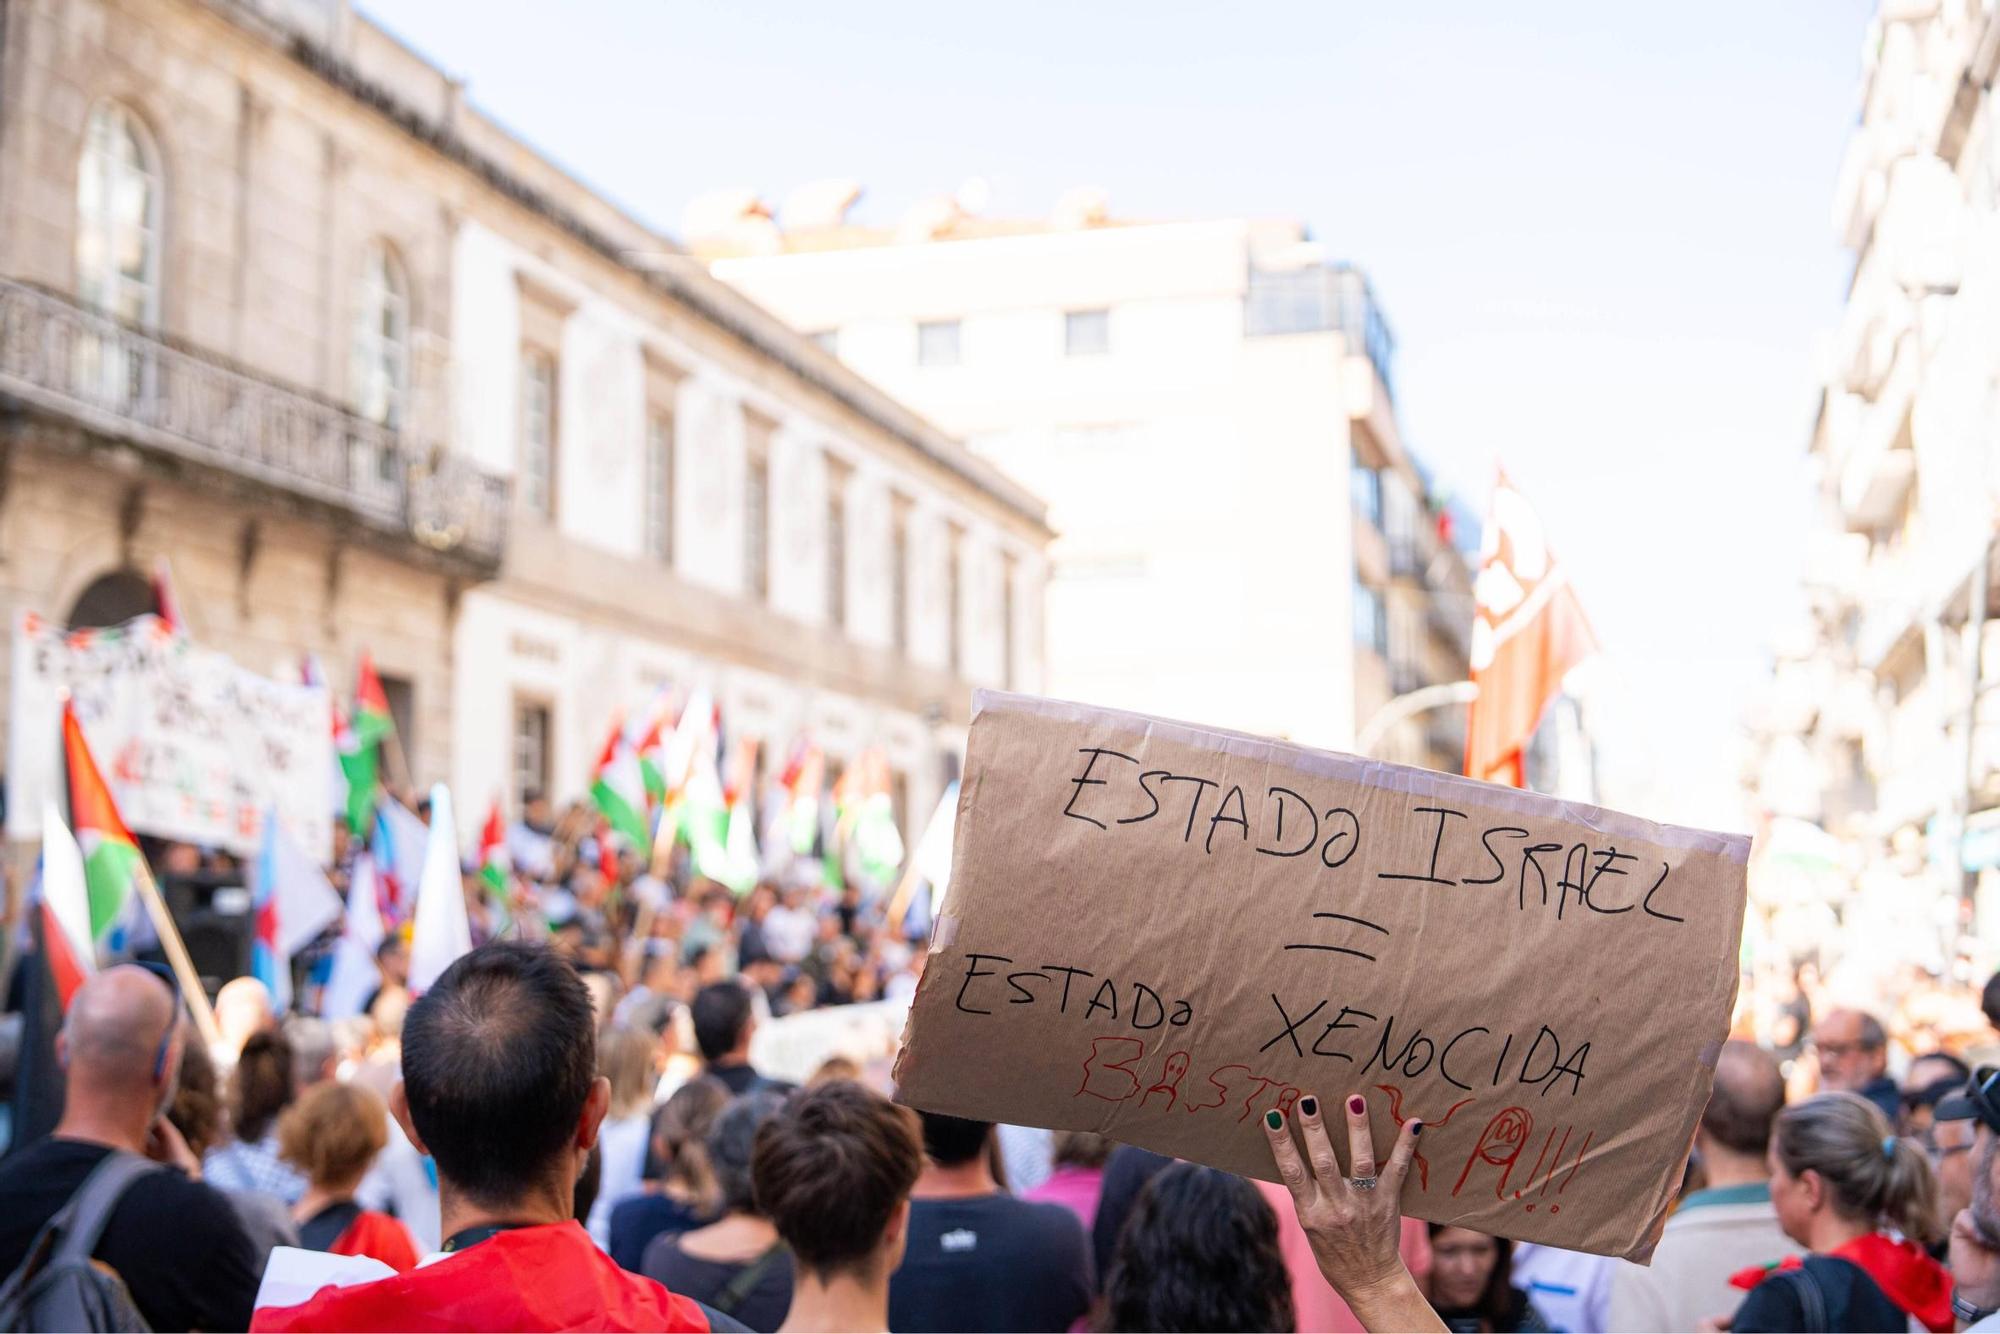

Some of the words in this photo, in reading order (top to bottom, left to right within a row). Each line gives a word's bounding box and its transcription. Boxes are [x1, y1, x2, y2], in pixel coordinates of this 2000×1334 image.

[1063, 748, 1361, 868] ESTADO
[1377, 807, 1685, 921] ISRAEL
[956, 953, 1193, 1030] ESTADO
[1259, 993, 1592, 1097] XENOCIDA
